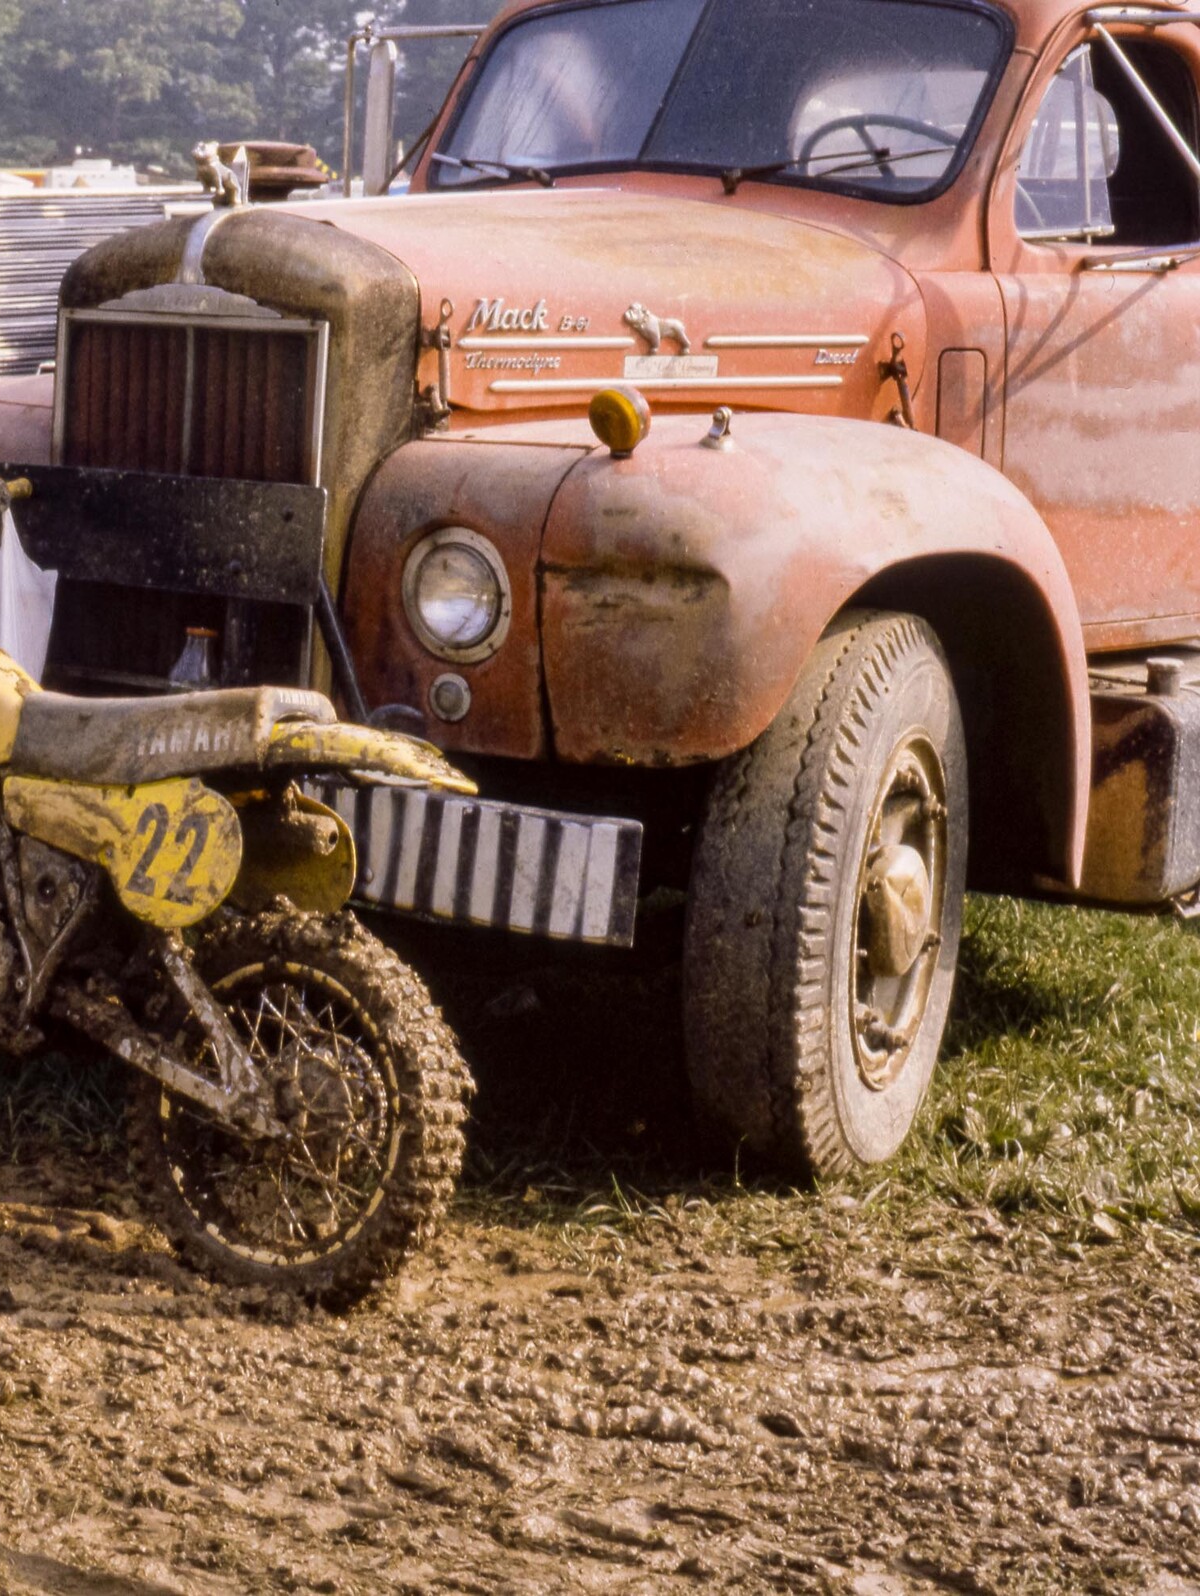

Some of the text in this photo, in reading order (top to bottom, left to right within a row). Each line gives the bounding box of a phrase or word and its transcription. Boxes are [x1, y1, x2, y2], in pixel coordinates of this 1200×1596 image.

[467, 298, 549, 331] Mack
[465, 351, 561, 376] Thermodyne
[124, 803, 209, 906] 22
